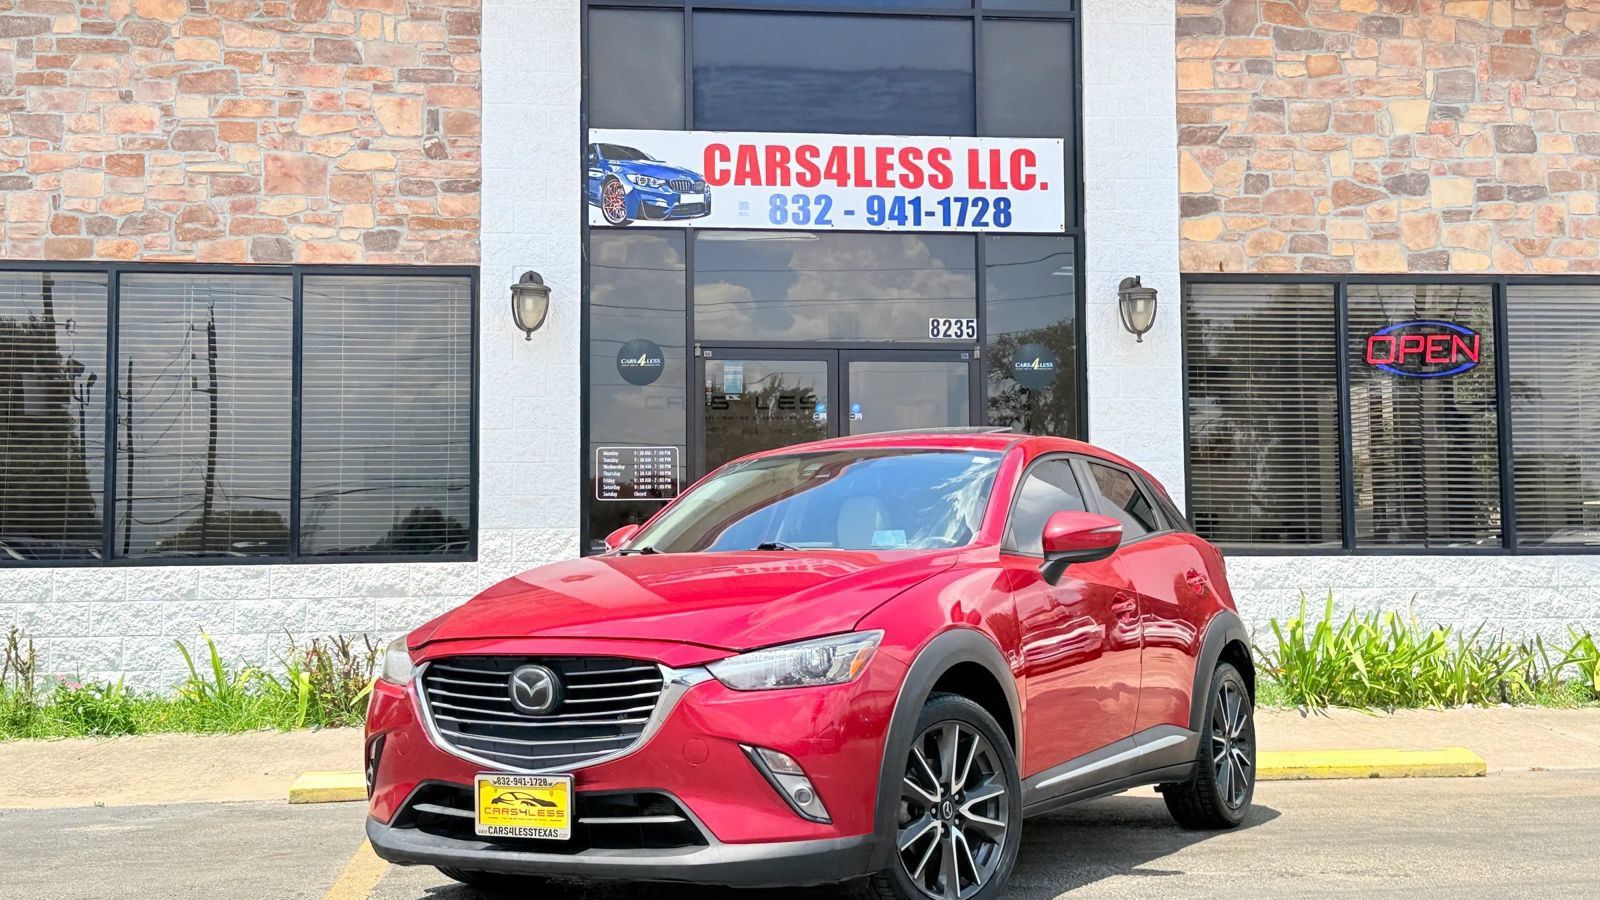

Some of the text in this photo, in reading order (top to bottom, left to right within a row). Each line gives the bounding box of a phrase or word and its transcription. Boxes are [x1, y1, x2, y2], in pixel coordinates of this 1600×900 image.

[703, 143, 1049, 191] CARS4LESS LLC.
[768, 193, 833, 225] 832
[866, 194, 1012, 228] 941-1728
[930, 318, 976, 338] 8235
[1366, 333, 1480, 364] OPEN
[496, 776, 548, 786] 832-941-1728
[484, 807, 565, 817] CARS4LESS
[488, 826, 559, 838] CARS4LESSTEXAS
